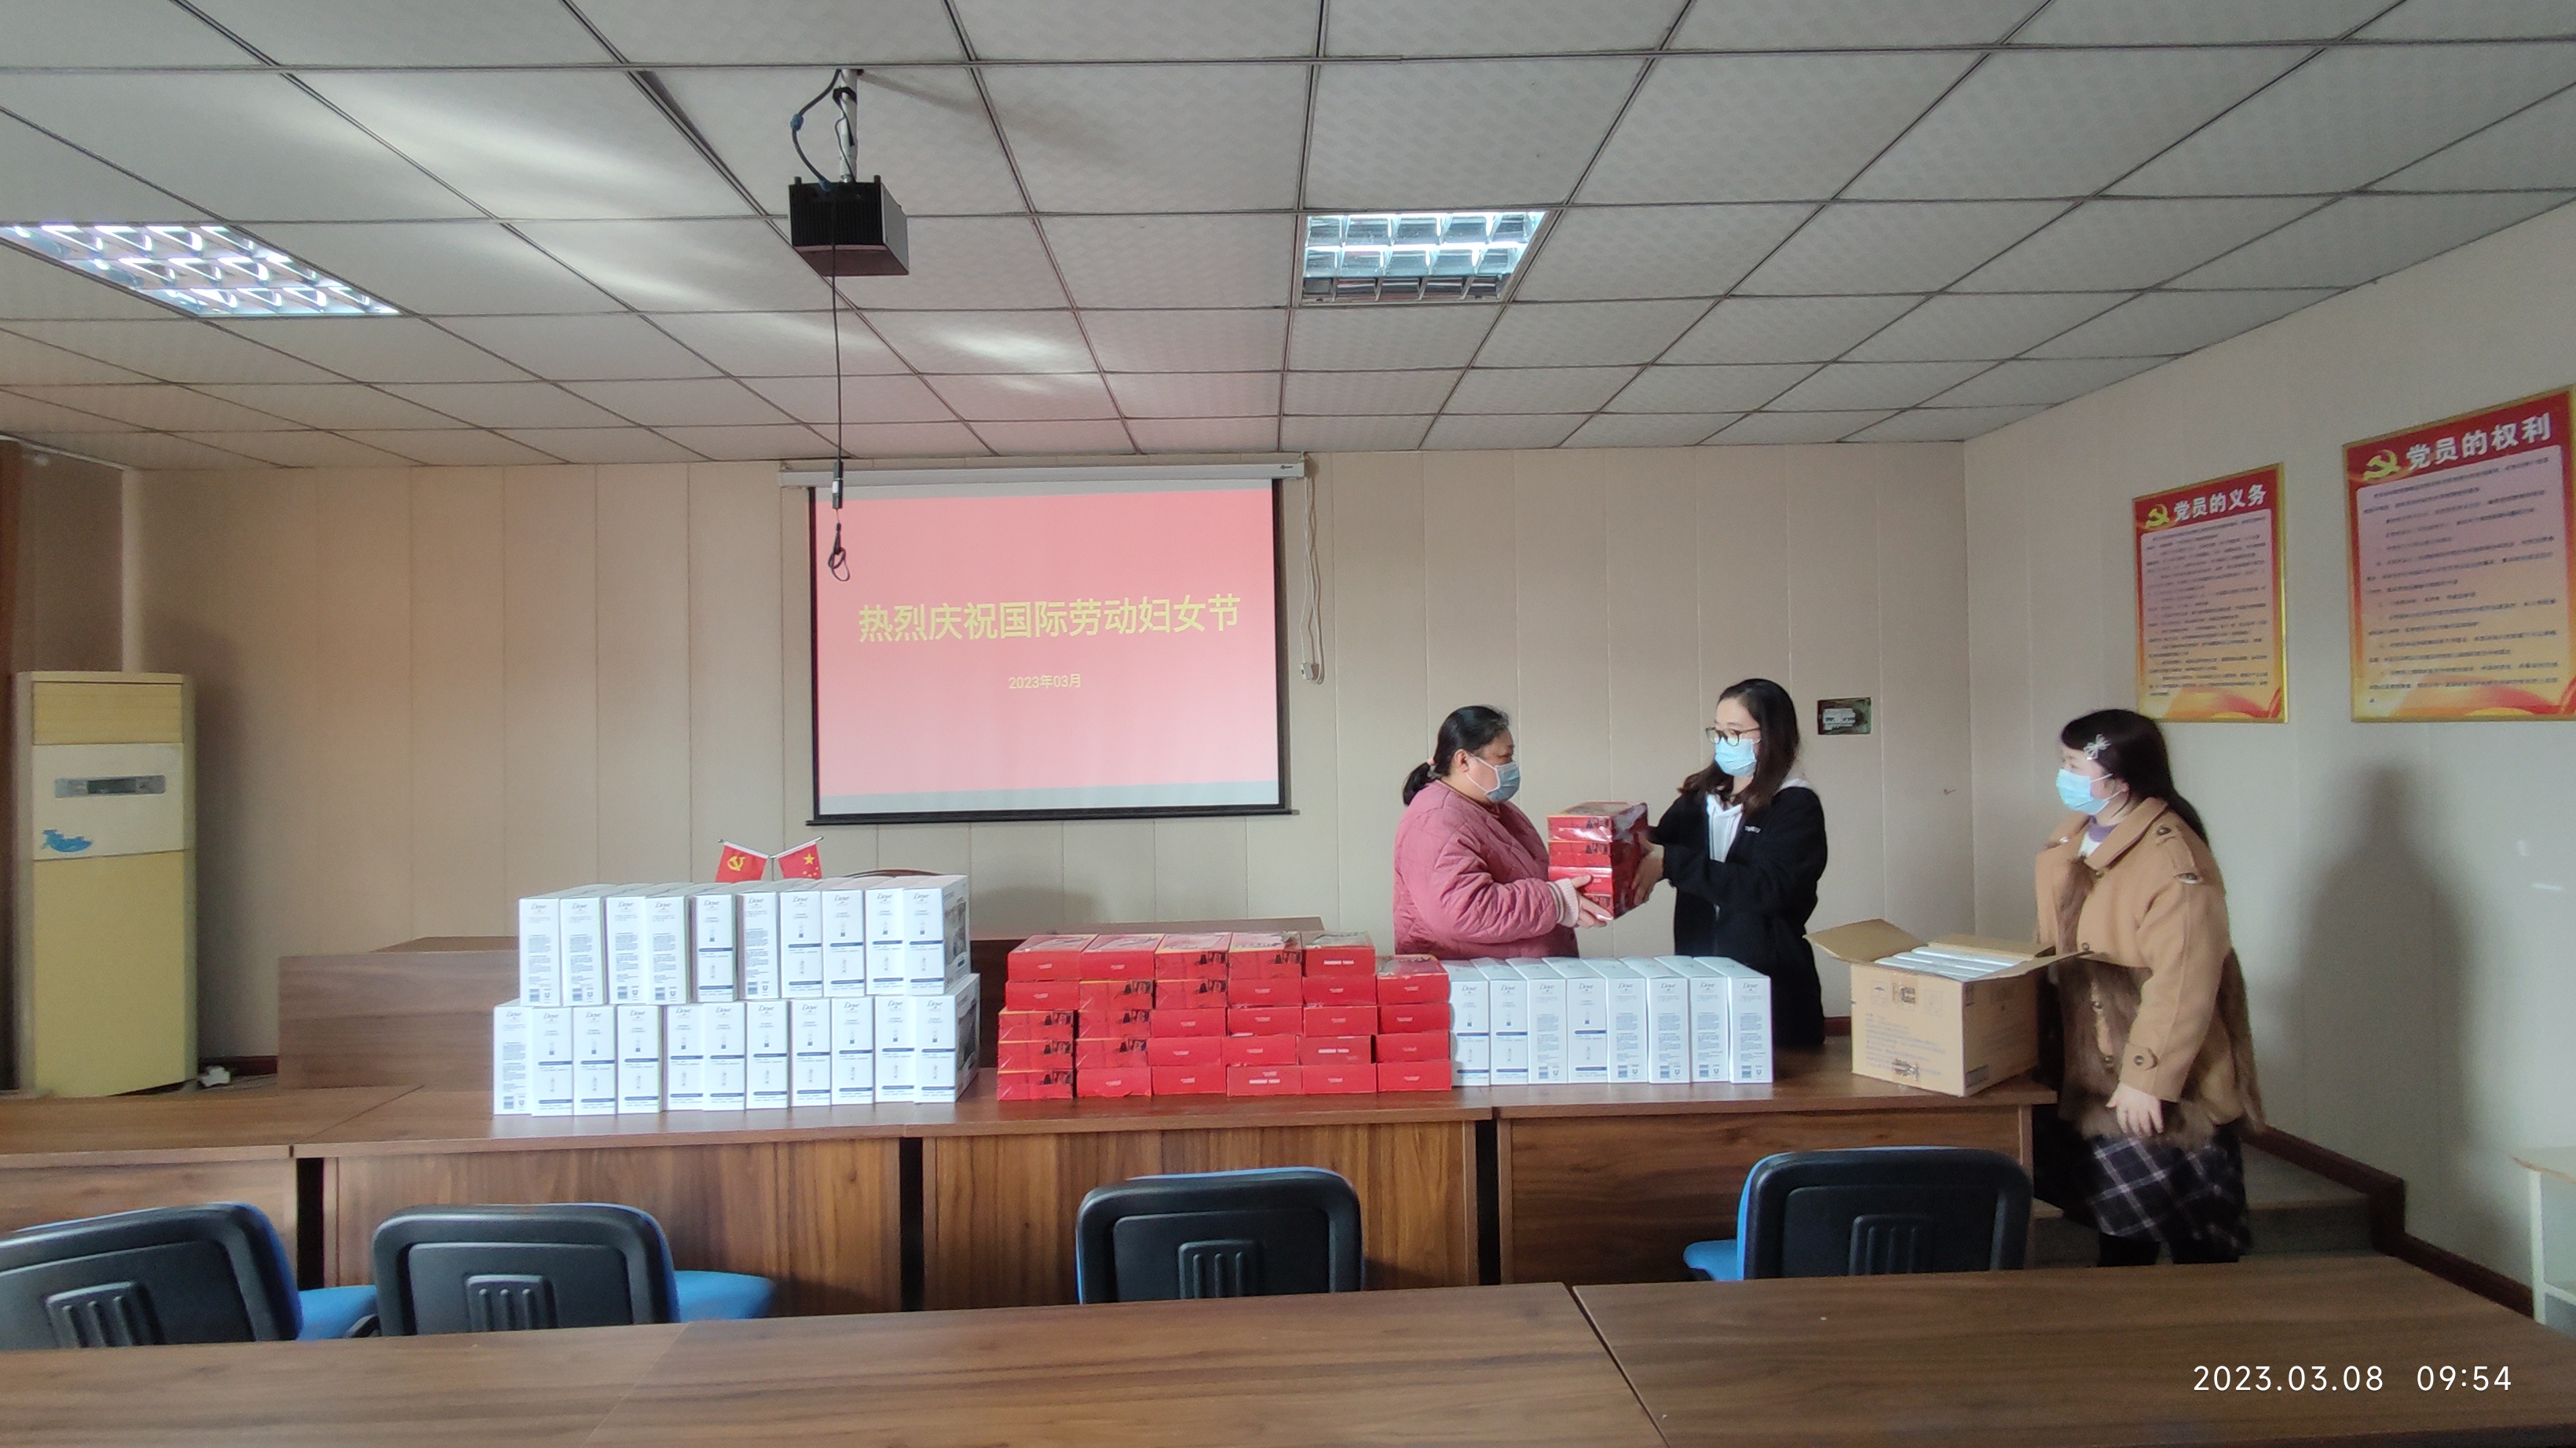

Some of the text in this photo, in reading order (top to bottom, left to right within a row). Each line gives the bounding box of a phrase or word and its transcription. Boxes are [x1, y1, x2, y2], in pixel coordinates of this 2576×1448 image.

[2406, 412, 2551, 471] 党员的权利
[2173, 484, 2267, 522] 党员的义务
[858, 593, 1241, 642] 热烈庆祝国际劳动妇女节
[1008, 673, 1082, 689] 2023年03月
